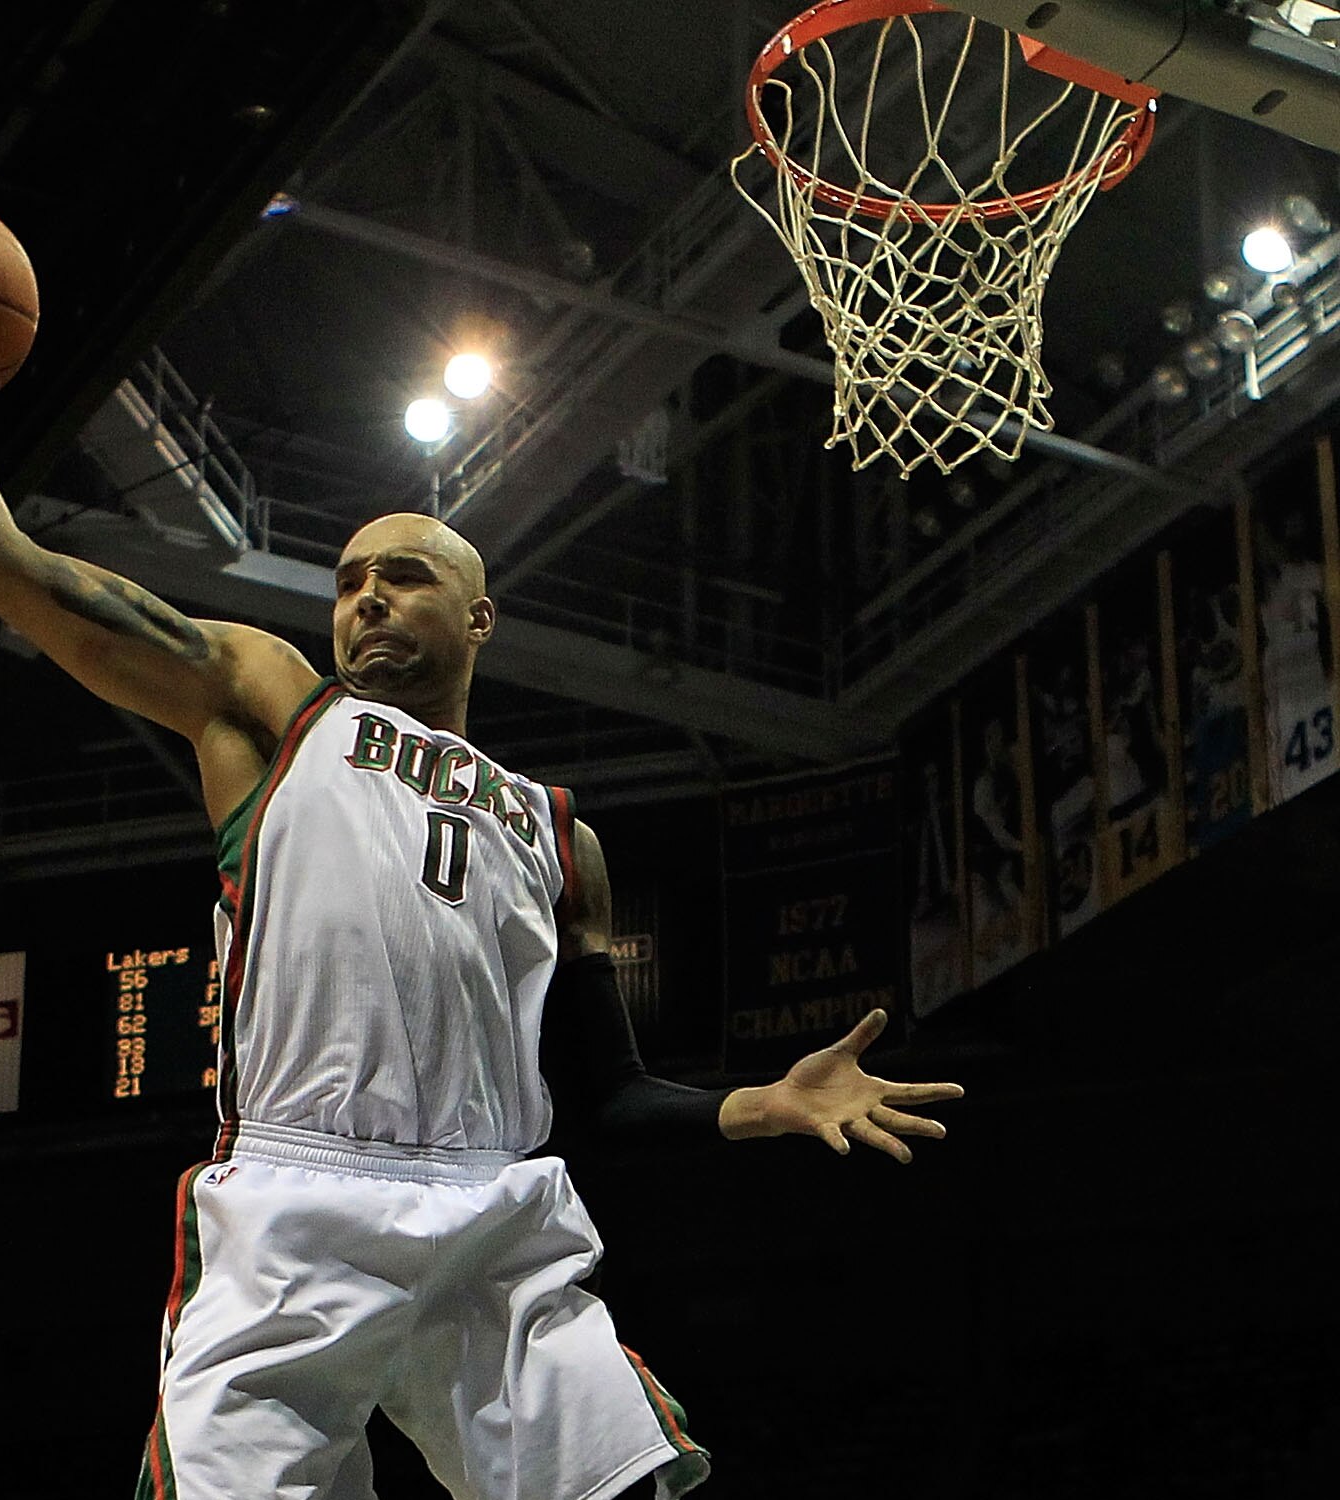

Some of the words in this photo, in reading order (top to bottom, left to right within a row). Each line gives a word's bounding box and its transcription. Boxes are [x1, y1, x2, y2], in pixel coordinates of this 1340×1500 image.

[1285, 707, 1333, 770] 43
[344, 711, 537, 848] BUCKS
[422, 811, 470, 903] 0
[107, 948, 189, 971] Lakers
[769, 944, 858, 986] NCAA
[120, 970, 148, 990] 56
[117, 1014, 147, 1034] 62
[115, 1077, 141, 1097] 21
